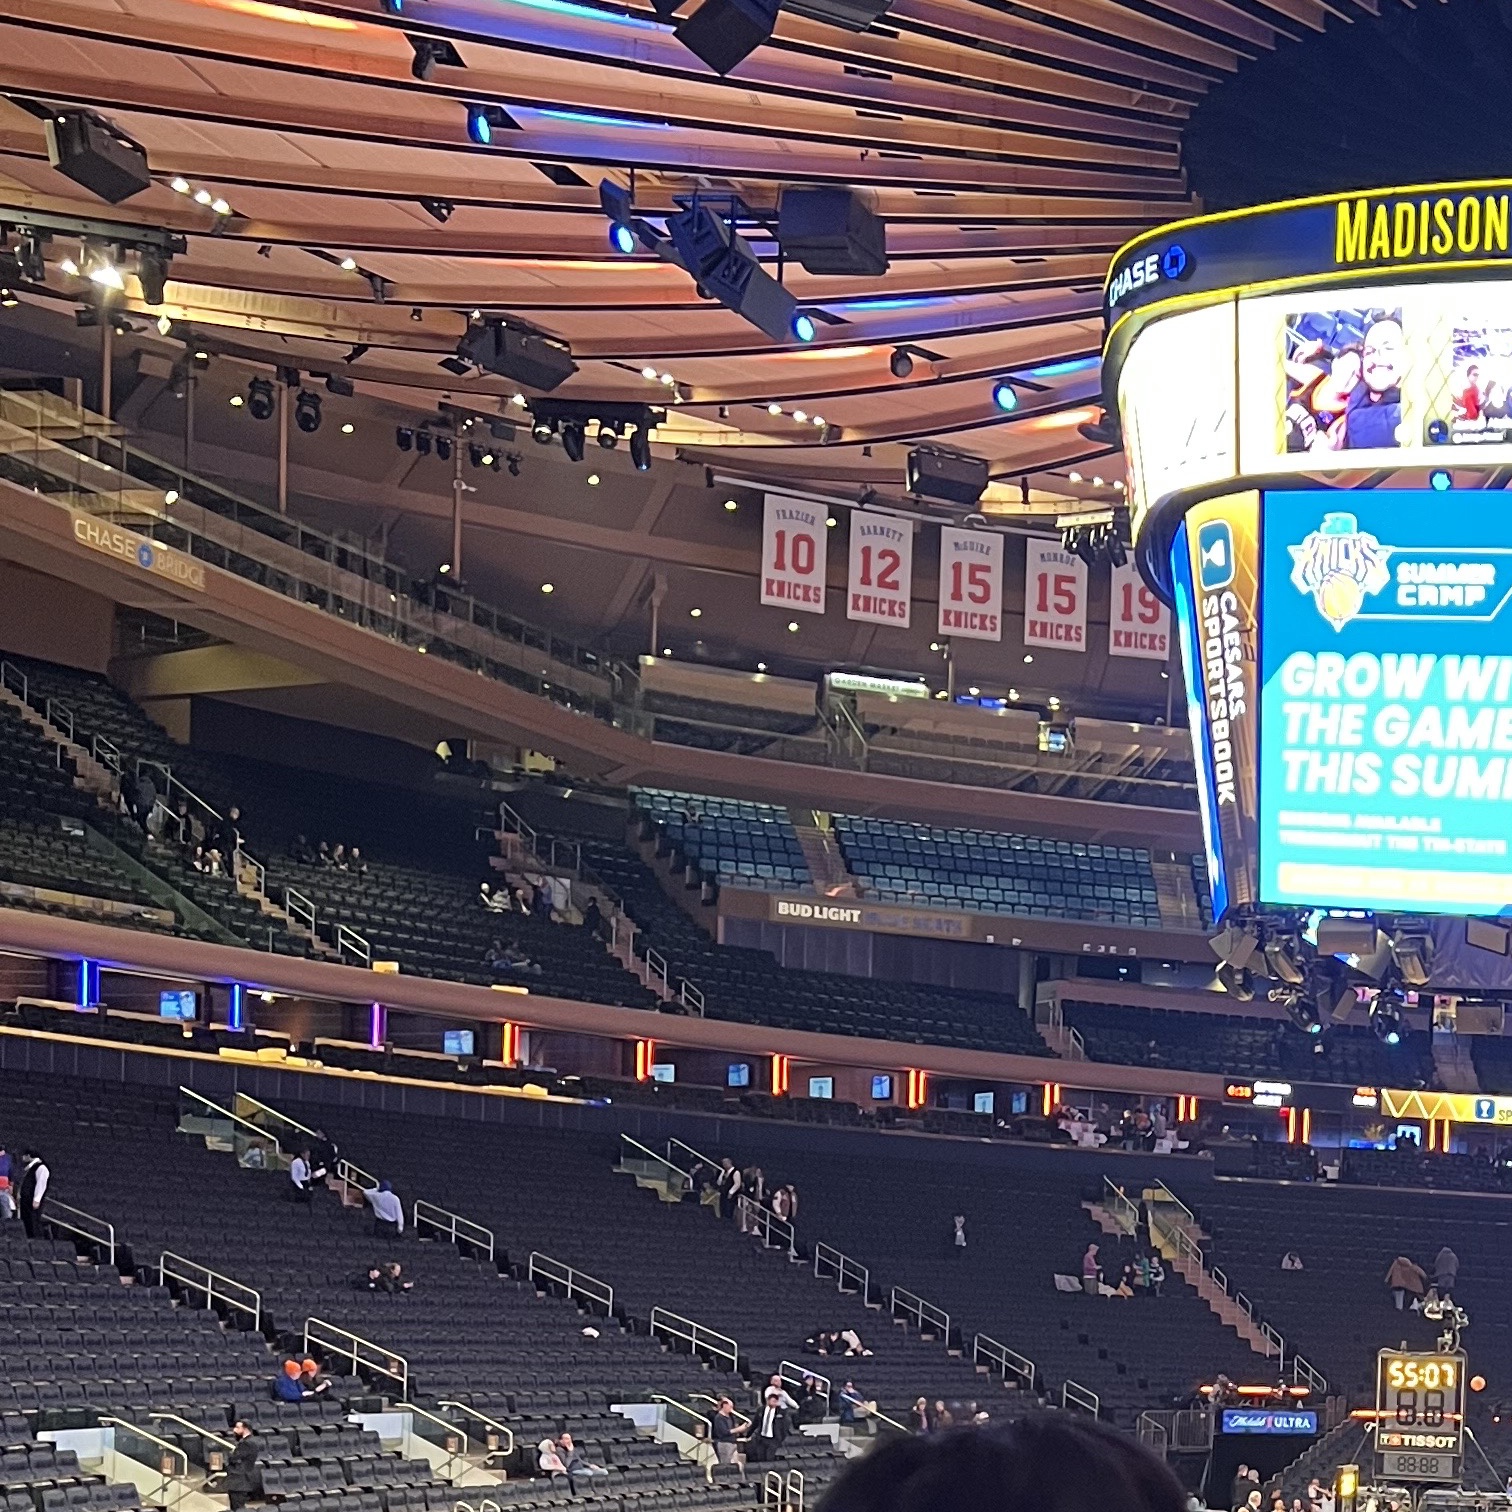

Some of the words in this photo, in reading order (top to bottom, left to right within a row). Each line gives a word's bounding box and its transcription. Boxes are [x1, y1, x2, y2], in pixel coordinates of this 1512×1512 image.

[1334, 194, 1508, 263] MADISON
[1109, 253, 1159, 307] CHASE
[74, 519, 136, 559] CHASE
[157, 552, 205, 588] BRIDGE
[774, 530, 815, 575] 10
[860, 545, 900, 591] 12
[765, 578, 822, 604] KNICKS
[951, 561, 991, 604] 15
[1037, 573, 1076, 615] 15
[1121, 582, 1160, 624] 19
[1397, 585, 1486, 606] CAMP
[852, 593, 906, 619] KNICKS
[942, 609, 997, 632] KNICKS
[1028, 619, 1082, 643] KNICKS
[1113, 630, 1166, 651] KNICKS
[1220, 591, 1247, 720] CAESARS
[1279, 652, 1437, 699] GROW
[1202, 594, 1236, 806] SPORTSBOOK
[1281, 703, 1366, 747] THE
[1281, 750, 1384, 796] THIS
[777, 901, 812, 917] BUD
[814, 905, 861, 923] LIGHT
[1389, 1360, 1454, 1388] 55:07
[1274, 1417, 1311, 1428] ULTRA
[1402, 1434, 1456, 1448] TISSOT
